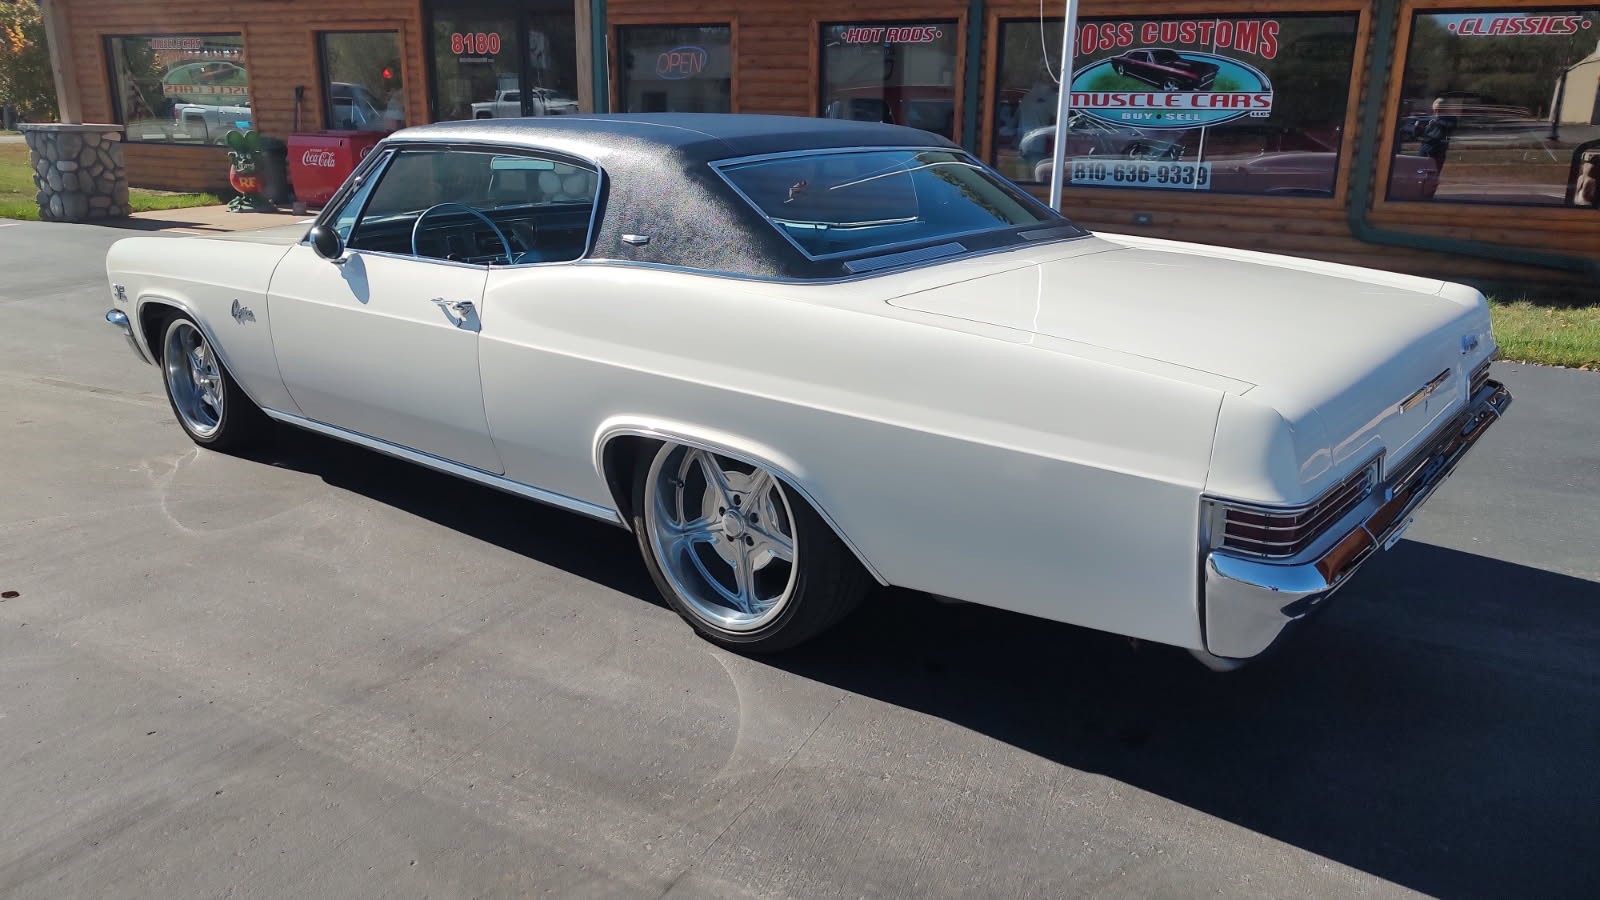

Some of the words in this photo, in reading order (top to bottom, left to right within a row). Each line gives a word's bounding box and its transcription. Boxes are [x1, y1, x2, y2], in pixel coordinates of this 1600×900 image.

[846, 27, 885, 43] HOT
[885, 26, 937, 43] RODS
[1457, 16, 1582, 36] CLASSICS
[451, 32, 501, 55] 8180
[1140, 20, 1280, 60] CUSTOMS
[656, 52, 703, 74] OPEN
[1069, 93, 1182, 108] MUSCLE
[1191, 93, 1272, 108] CARS
[1121, 112, 1153, 120] BUY
[1165, 112, 1201, 121] SELL
[1073, 162, 1209, 186] 810-636-9339
